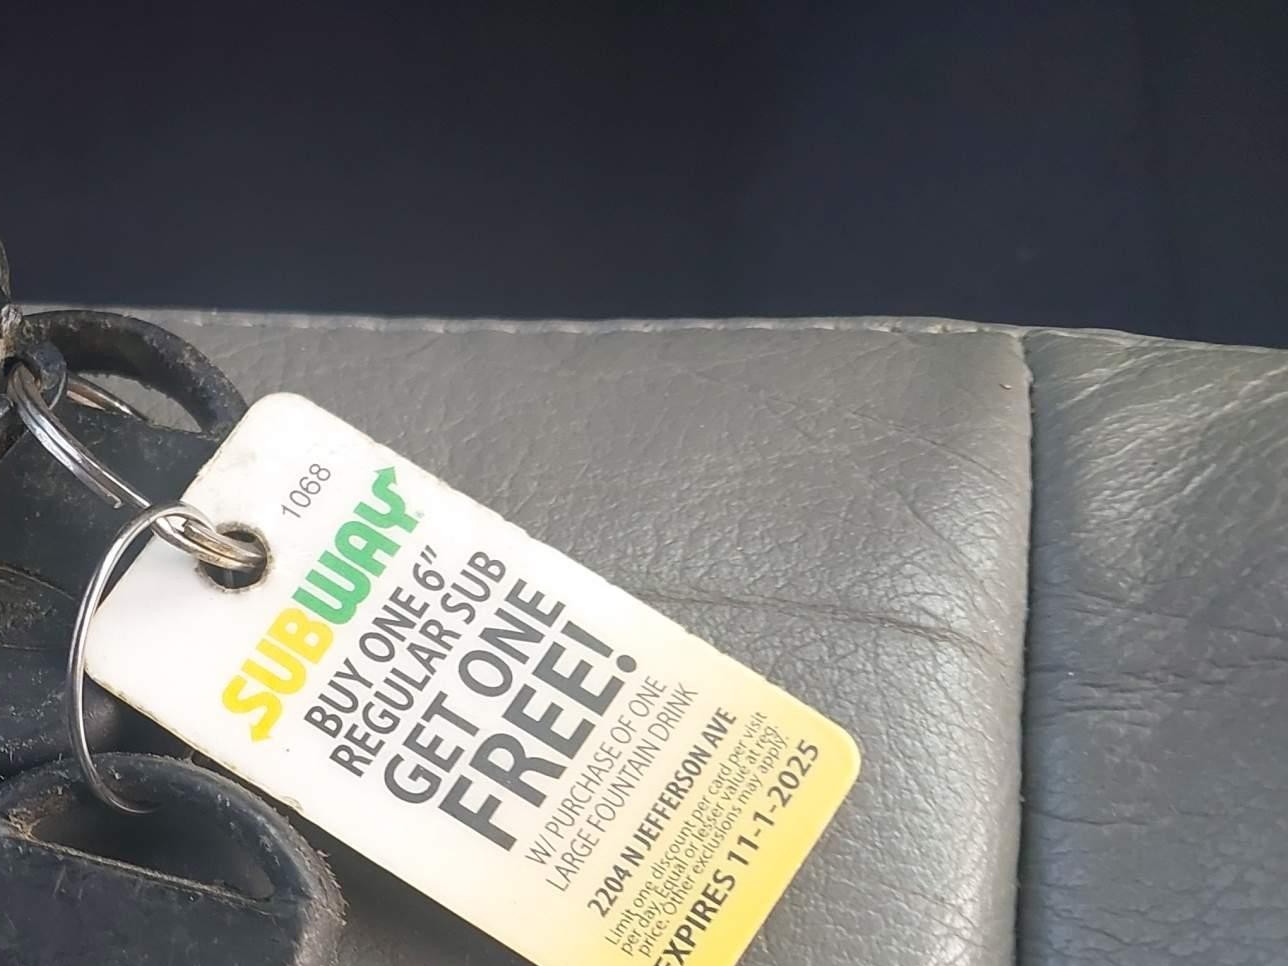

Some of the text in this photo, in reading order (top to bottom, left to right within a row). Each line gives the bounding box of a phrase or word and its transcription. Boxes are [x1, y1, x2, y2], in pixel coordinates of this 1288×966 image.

[281, 463, 331, 518] 1068
[221, 466, 419, 742] SUBWAY
[303, 657, 373, 738] BUY
[358, 586, 430, 662] ONE
[328, 551, 506, 777] REGULAR SUB
[383, 578, 565, 804] GET ONE
[437, 620, 637, 851] FREE!
[524, 675, 667, 864] W/ PURCHASE OF ONE
[545, 682, 698, 891] LARGE FOUNTAIN DRINK
[587, 707, 736, 917] 2204 N JEFFERSON AVE
[604, 711, 767, 945] Limit one discount per card per visit
[727, 739, 818, 865] 11-1-2025
[620, 928, 641, 956] per
[653, 856, 688, 898] Equal
[690, 801, 724, 842] lesser
[720, 762, 750, 800] value
[637, 919, 670, 957] price.
[662, 874, 695, 915] Other
[692, 805, 741, 874] exclusions
[737, 773, 763, 804] may
